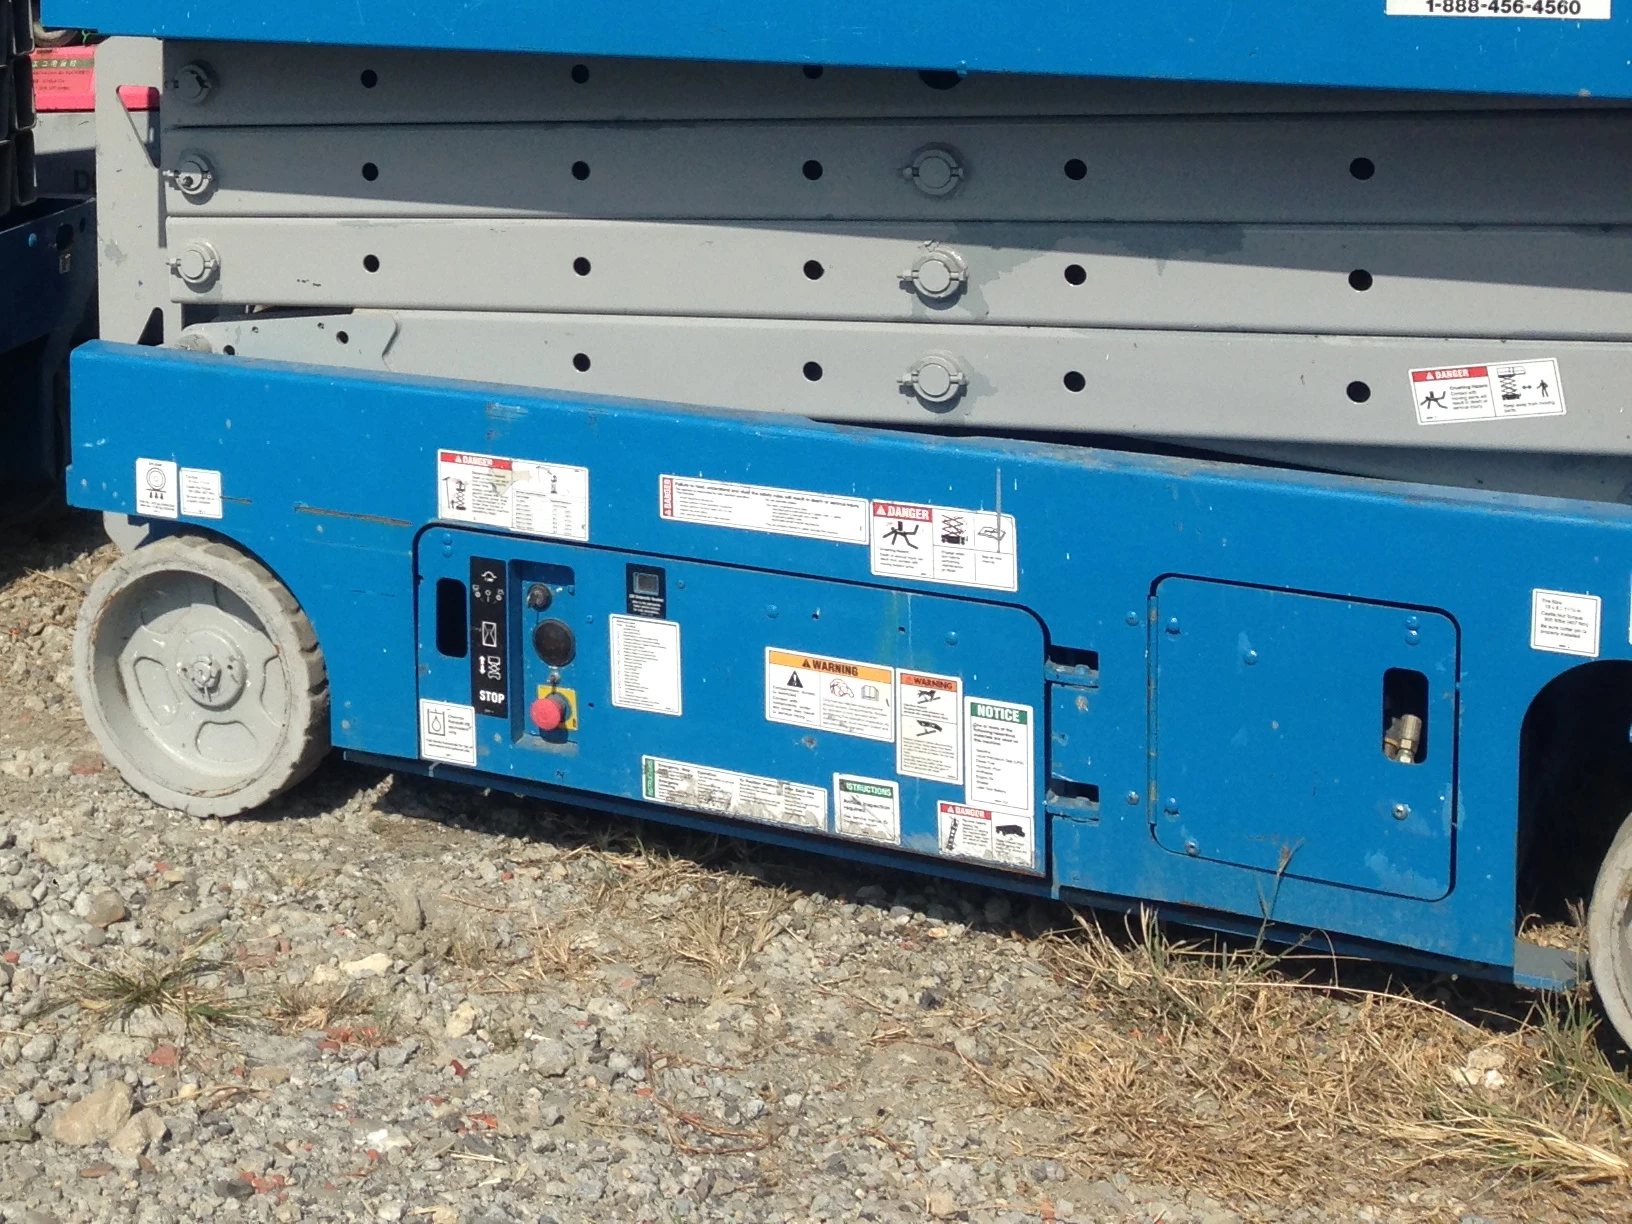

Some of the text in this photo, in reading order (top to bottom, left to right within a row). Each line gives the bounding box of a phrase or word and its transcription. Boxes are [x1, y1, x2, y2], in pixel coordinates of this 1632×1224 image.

[1435, 368, 1470, 379] DANGER
[888, 505, 929, 520] DANGER
[812, 659, 859, 676] WARNING
[914, 676, 953, 690] WARNING
[479, 689, 505, 704] STOP
[977, 704, 1020, 723] NOTICE
